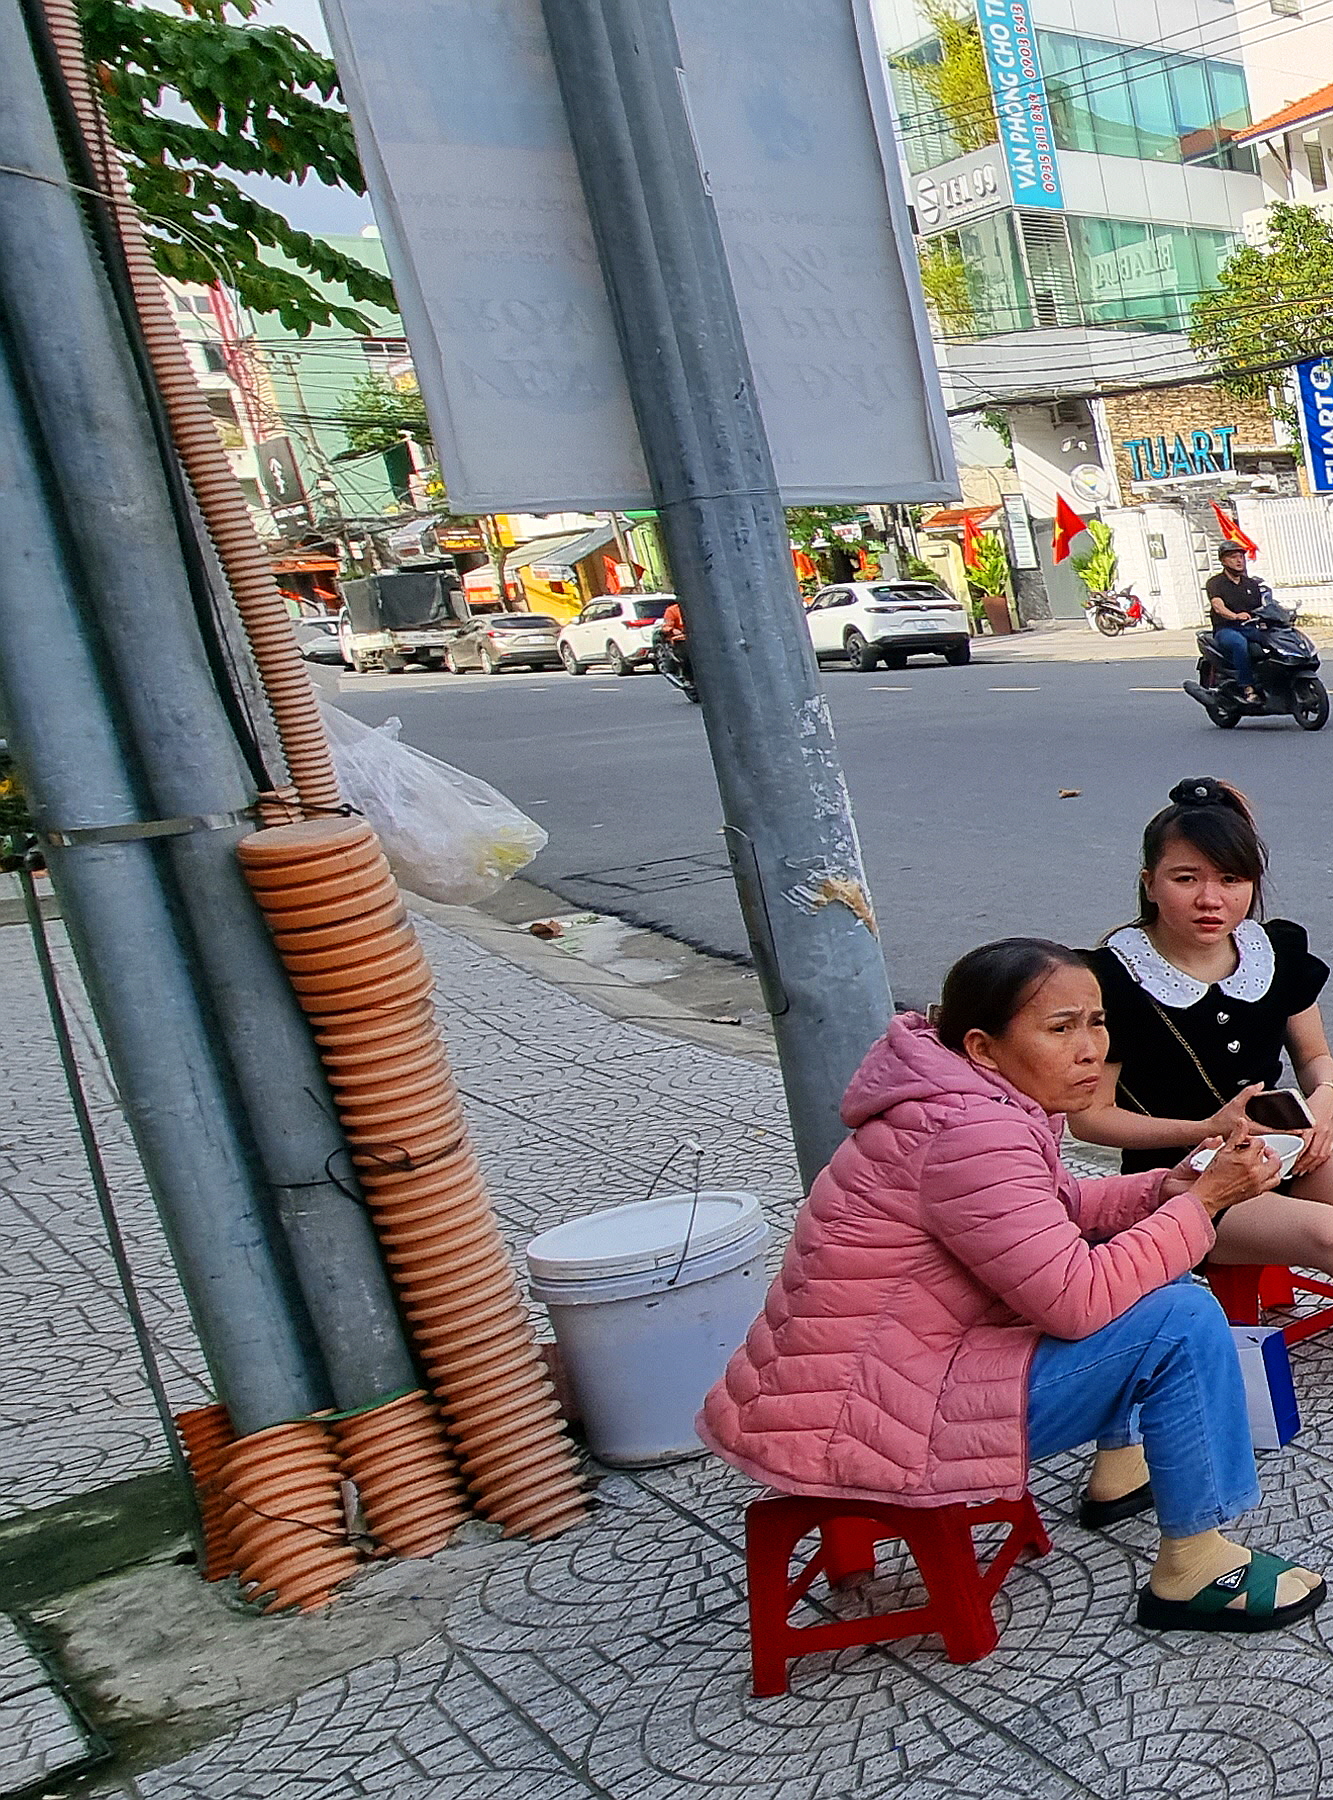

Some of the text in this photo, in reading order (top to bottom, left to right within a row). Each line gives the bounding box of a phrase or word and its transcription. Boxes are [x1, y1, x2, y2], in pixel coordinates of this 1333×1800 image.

[989, 22, 1016, 69] CHO
[1016, 37, 1036, 80] 0903
[1034, 125, 1050, 152] 313
[973, 163, 997, 197] 99
[1011, 148, 1037, 190] VĂN
[1038, 154, 1057, 193] 0935
[1123, 425, 1238, 482] TUART
